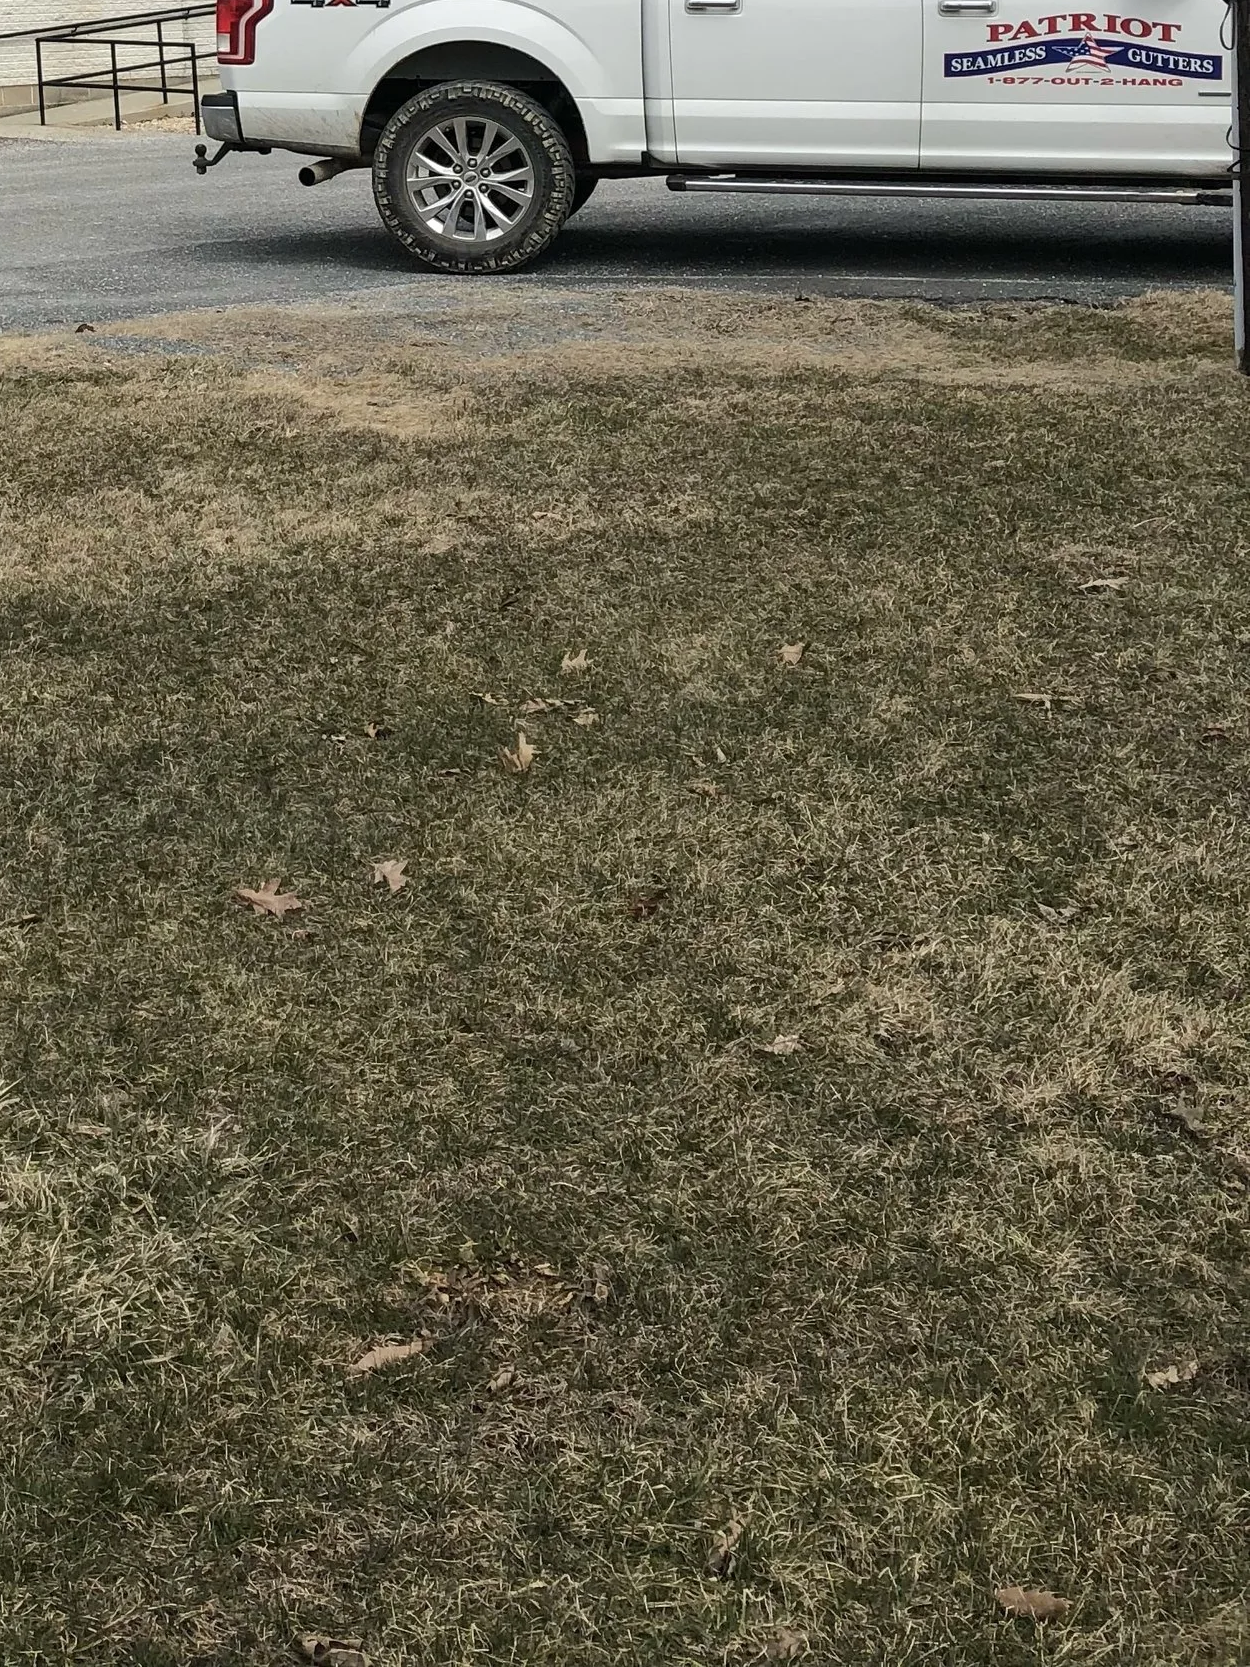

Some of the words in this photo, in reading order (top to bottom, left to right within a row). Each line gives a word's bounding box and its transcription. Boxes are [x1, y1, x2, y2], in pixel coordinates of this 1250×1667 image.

[986, 13, 1182, 43] PATRIOT
[951, 45, 1047, 72] SEAMLESS
[1127, 48, 1215, 74] GUTTERS
[987, 77, 1184, 87] 1-877-OUT-2-HANG
